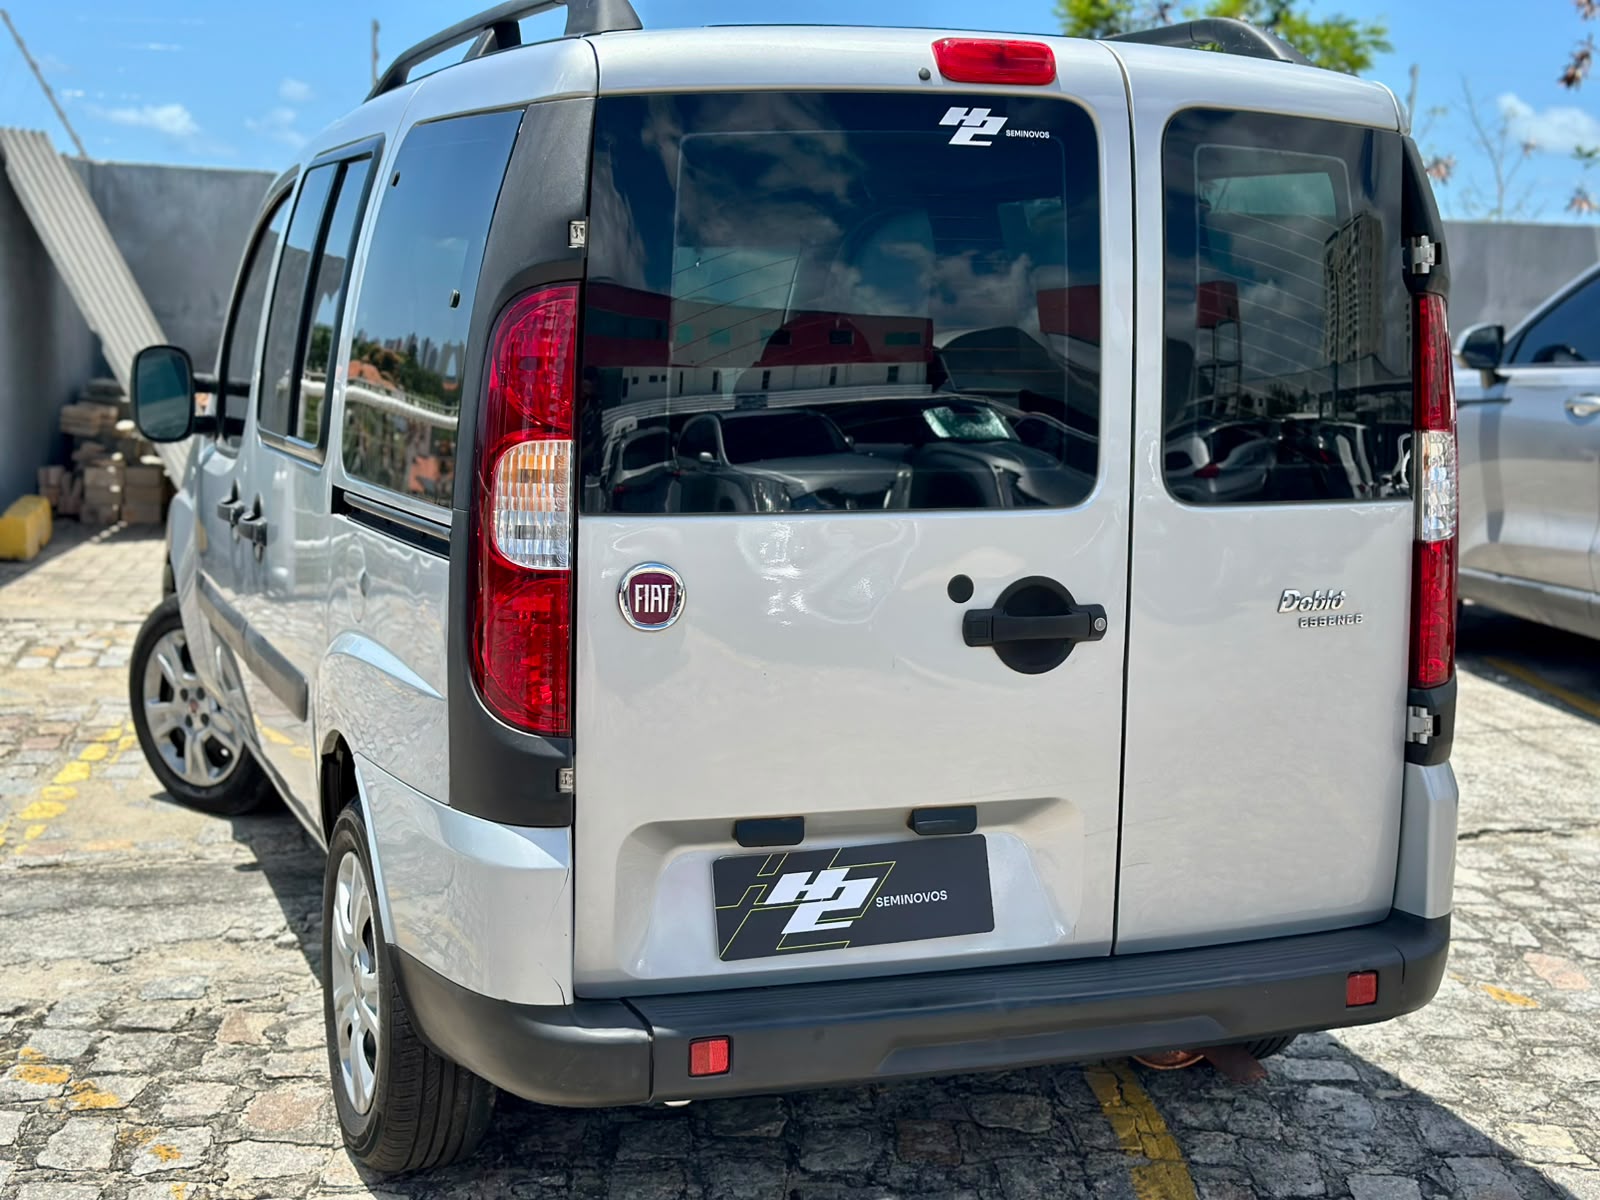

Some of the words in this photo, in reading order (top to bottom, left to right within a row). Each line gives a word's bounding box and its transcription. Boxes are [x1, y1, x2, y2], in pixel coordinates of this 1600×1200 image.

[1005, 129, 1050, 139] SEMINOVOS
[635, 584, 672, 613] FIAT
[1298, 613, 1364, 629] ESSENCE
[875, 890, 948, 908] SEMINOVOS
